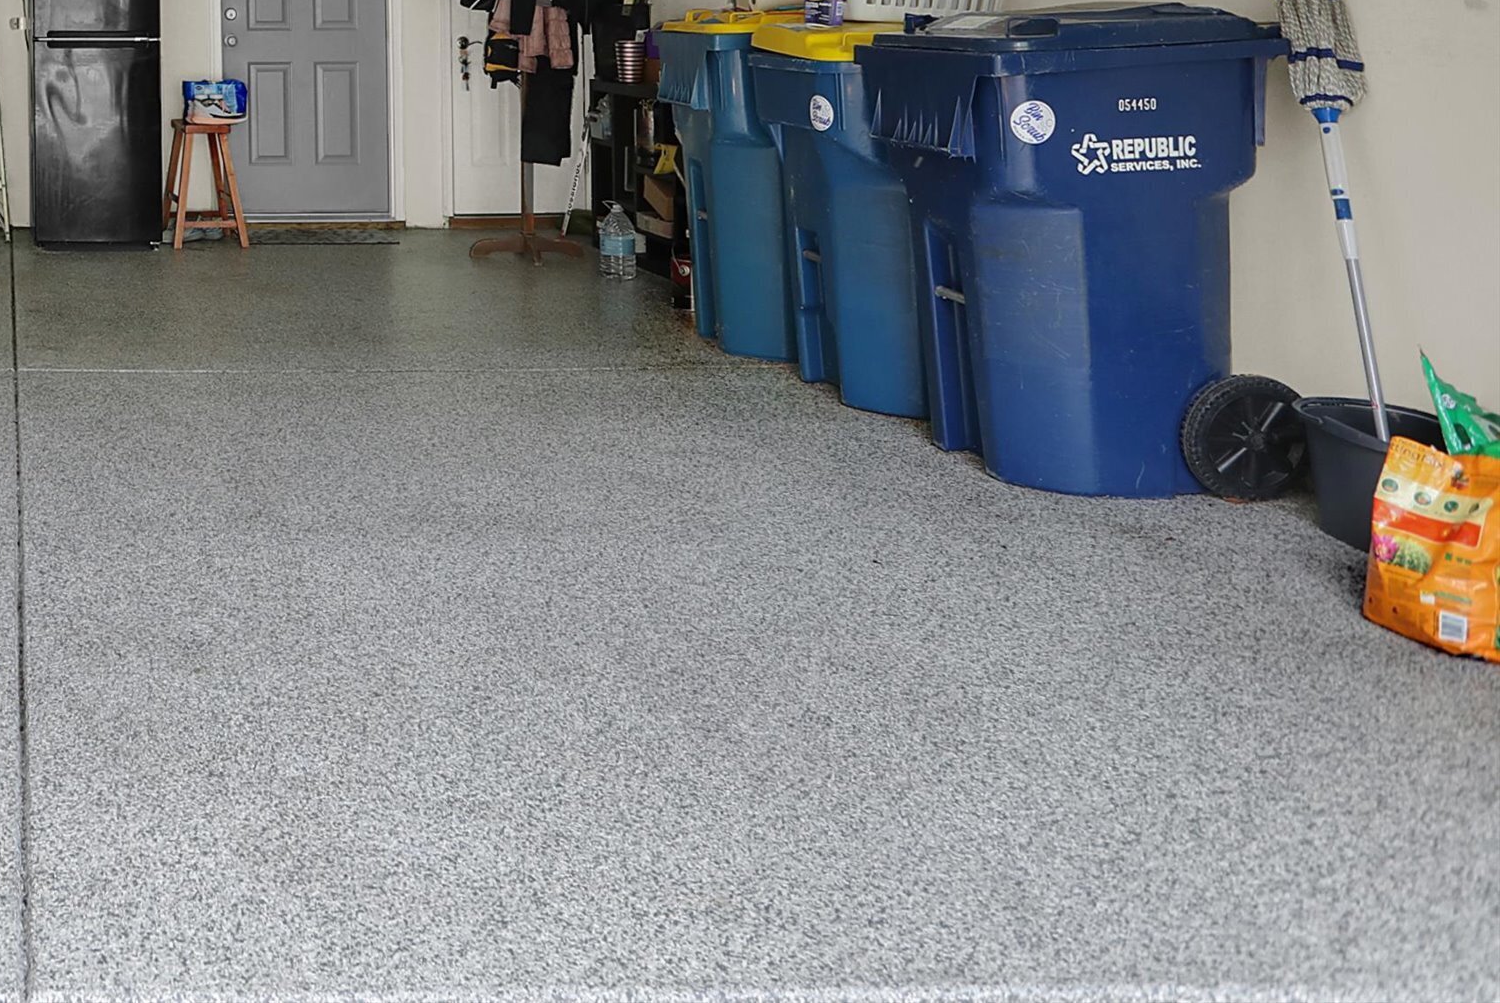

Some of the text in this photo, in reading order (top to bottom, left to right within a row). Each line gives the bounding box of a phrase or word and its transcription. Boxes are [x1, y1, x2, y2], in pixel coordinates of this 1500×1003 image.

[1118, 98, 1157, 112] 054450
[1111, 135, 1197, 160] REPUBLIC
[1110, 158, 1202, 172] SERVICES, INC.
